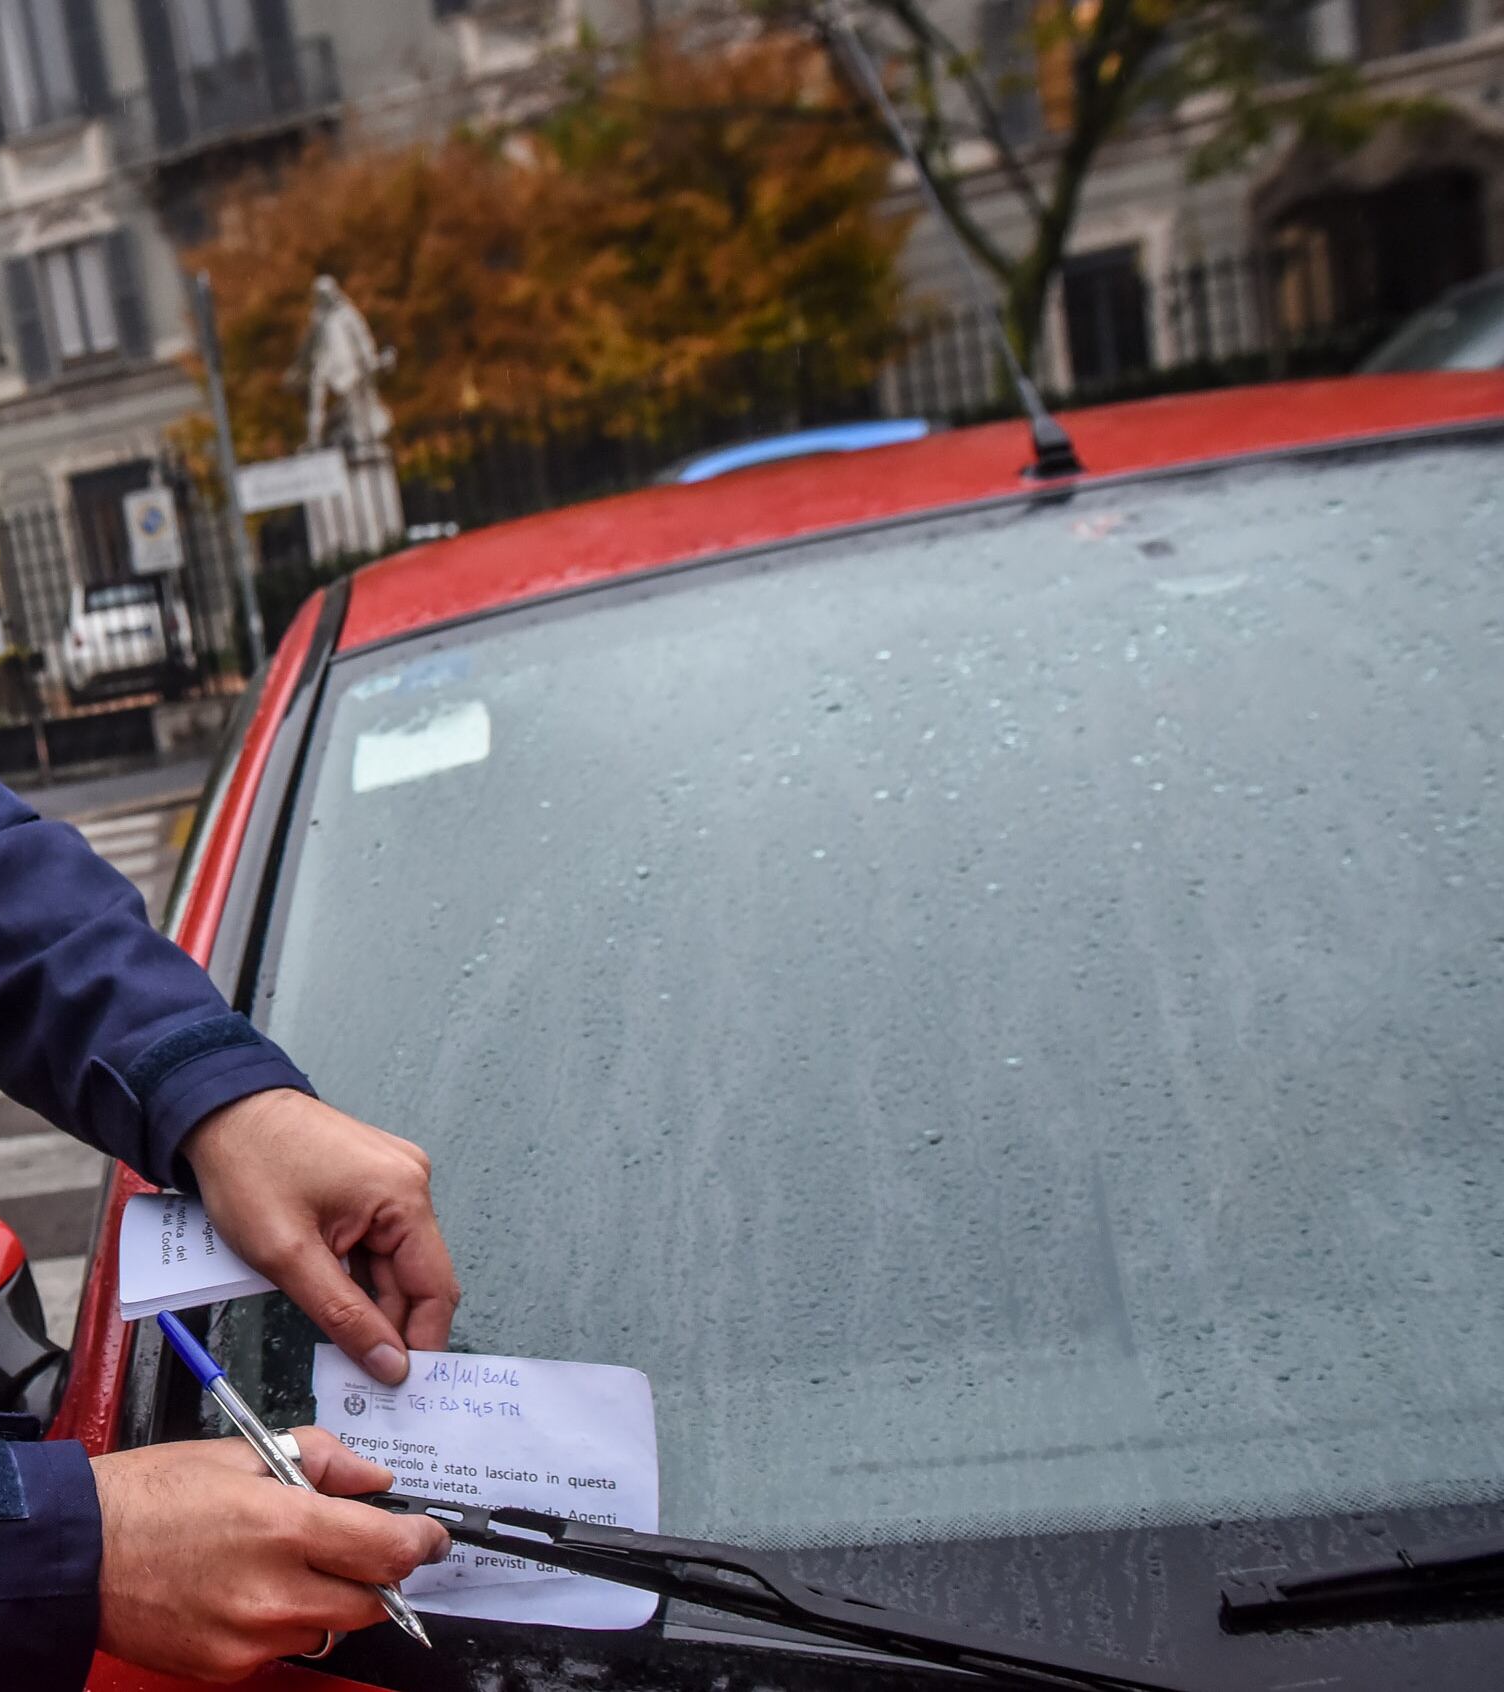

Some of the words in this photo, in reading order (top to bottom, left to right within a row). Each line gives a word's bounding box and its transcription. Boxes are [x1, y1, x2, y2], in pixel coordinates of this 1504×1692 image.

[162, 1231, 173, 1265] Codice
[176, 1245, 187, 1262] del
[340, 1433, 389, 1450] Egregio
[392, 1439, 439, 1456] Signore,
[384, 1456, 424, 1471] veicolo
[430, 1461, 438, 1472] è
[444, 1464, 477, 1477] stato
[485, 1466, 538, 1483] lasciato
[546, 1472, 559, 1485] in
[568, 1476, 617, 1490] questa
[400, 1476, 429, 1489] sosta
[433, 1479, 482, 1495] vietata.
[475, 1554, 527, 1570] previsti
